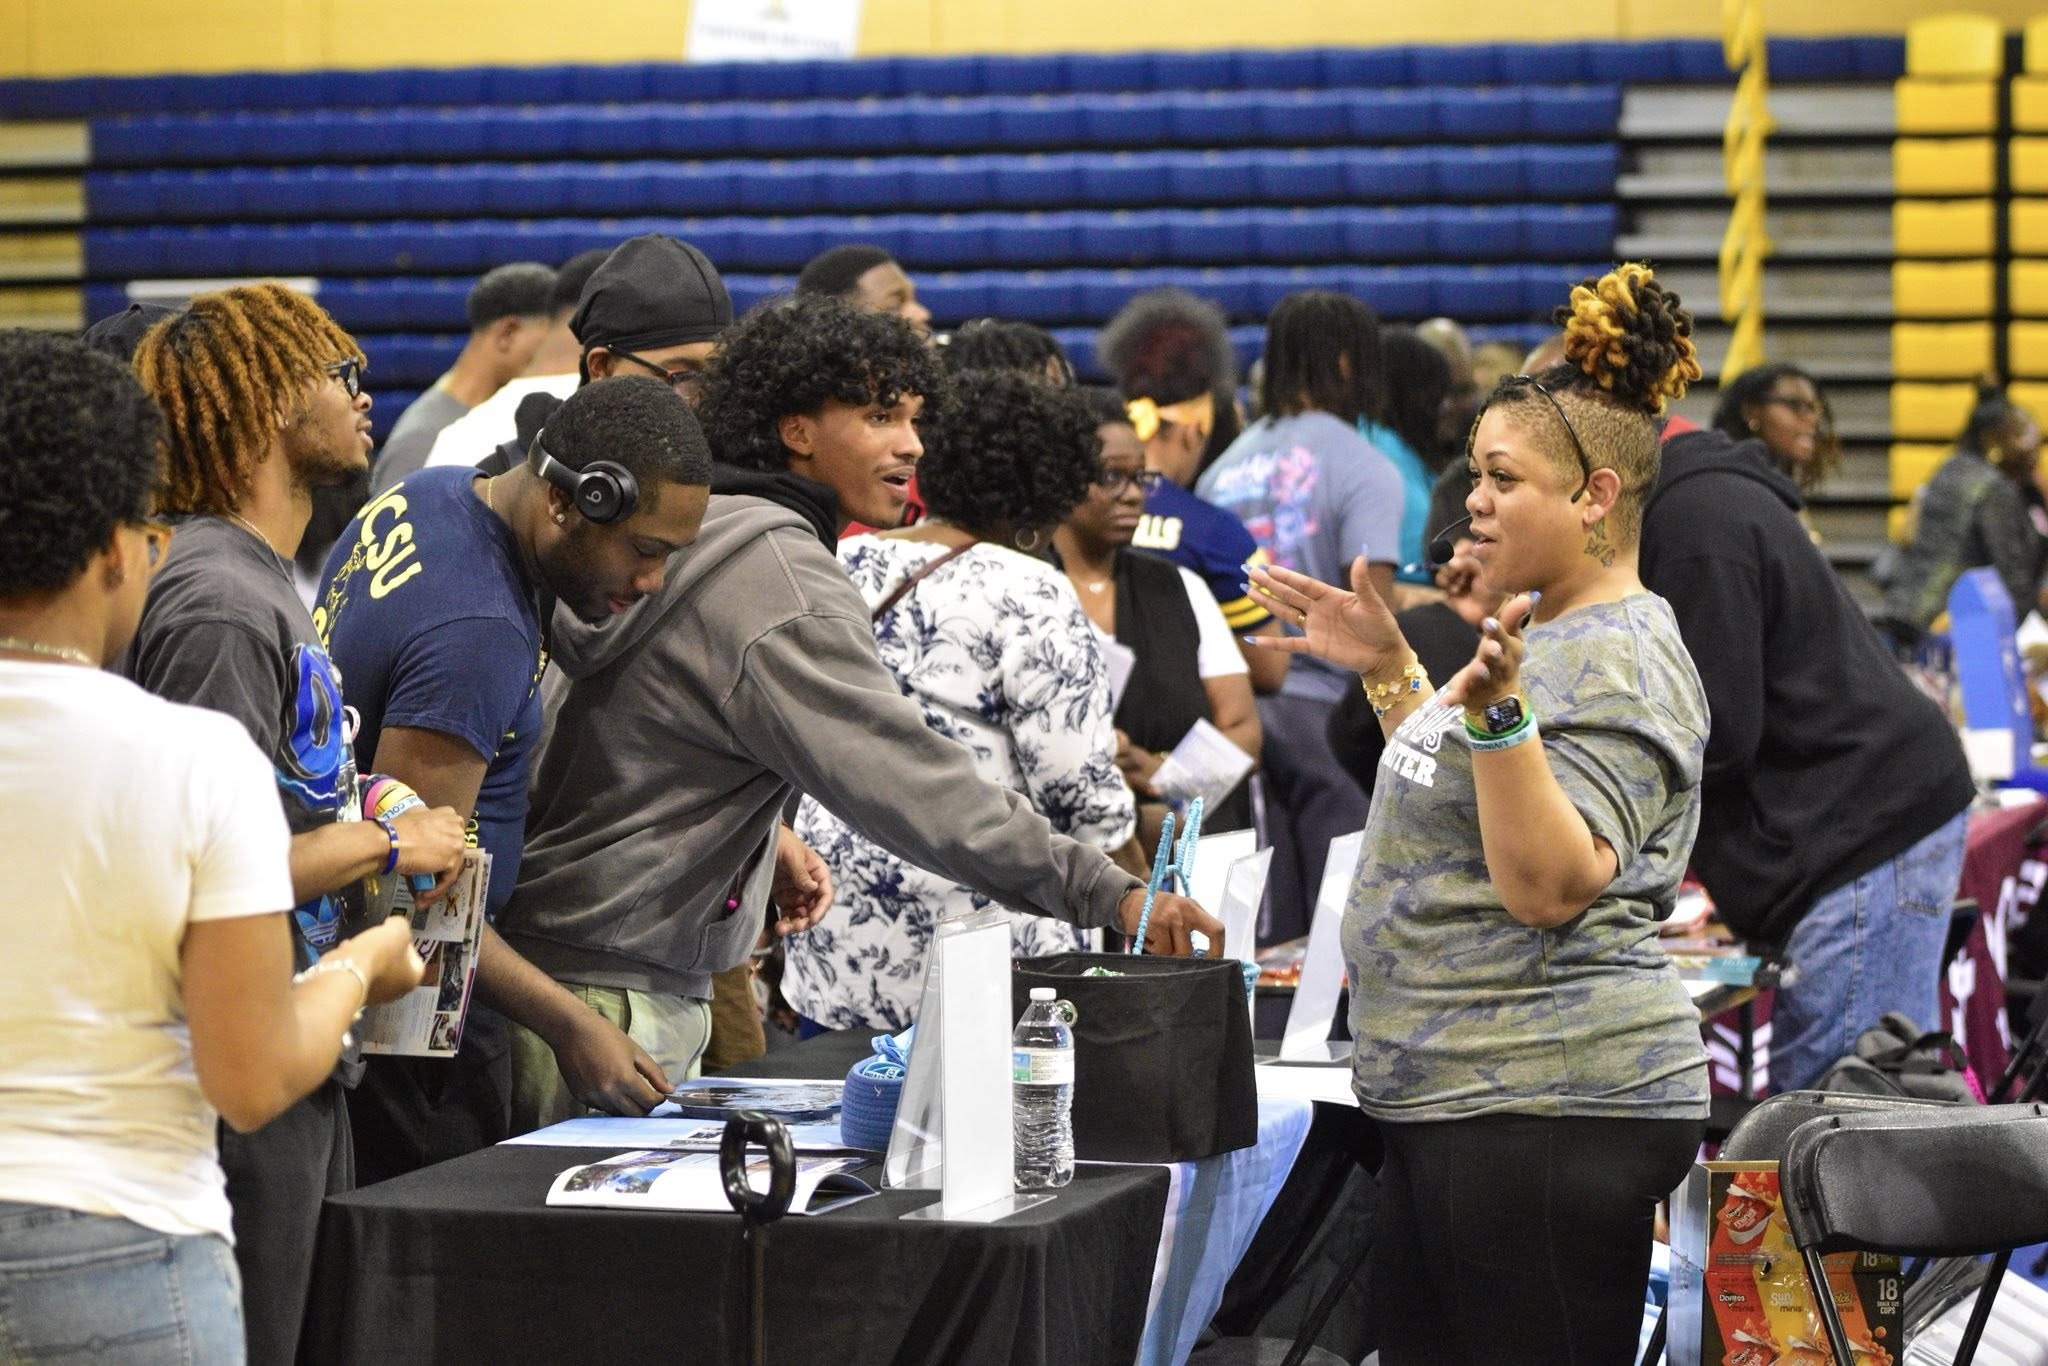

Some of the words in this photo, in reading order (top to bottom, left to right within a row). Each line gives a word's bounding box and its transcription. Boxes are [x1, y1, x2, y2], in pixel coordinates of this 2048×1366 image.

[1381, 738, 1438, 788] NTER
[382, 803, 406, 820] COLL
[1878, 1278, 1898, 1301] 18
[1719, 1294, 1746, 1303] Doritos
[1779, 1304, 1803, 1313] minis
